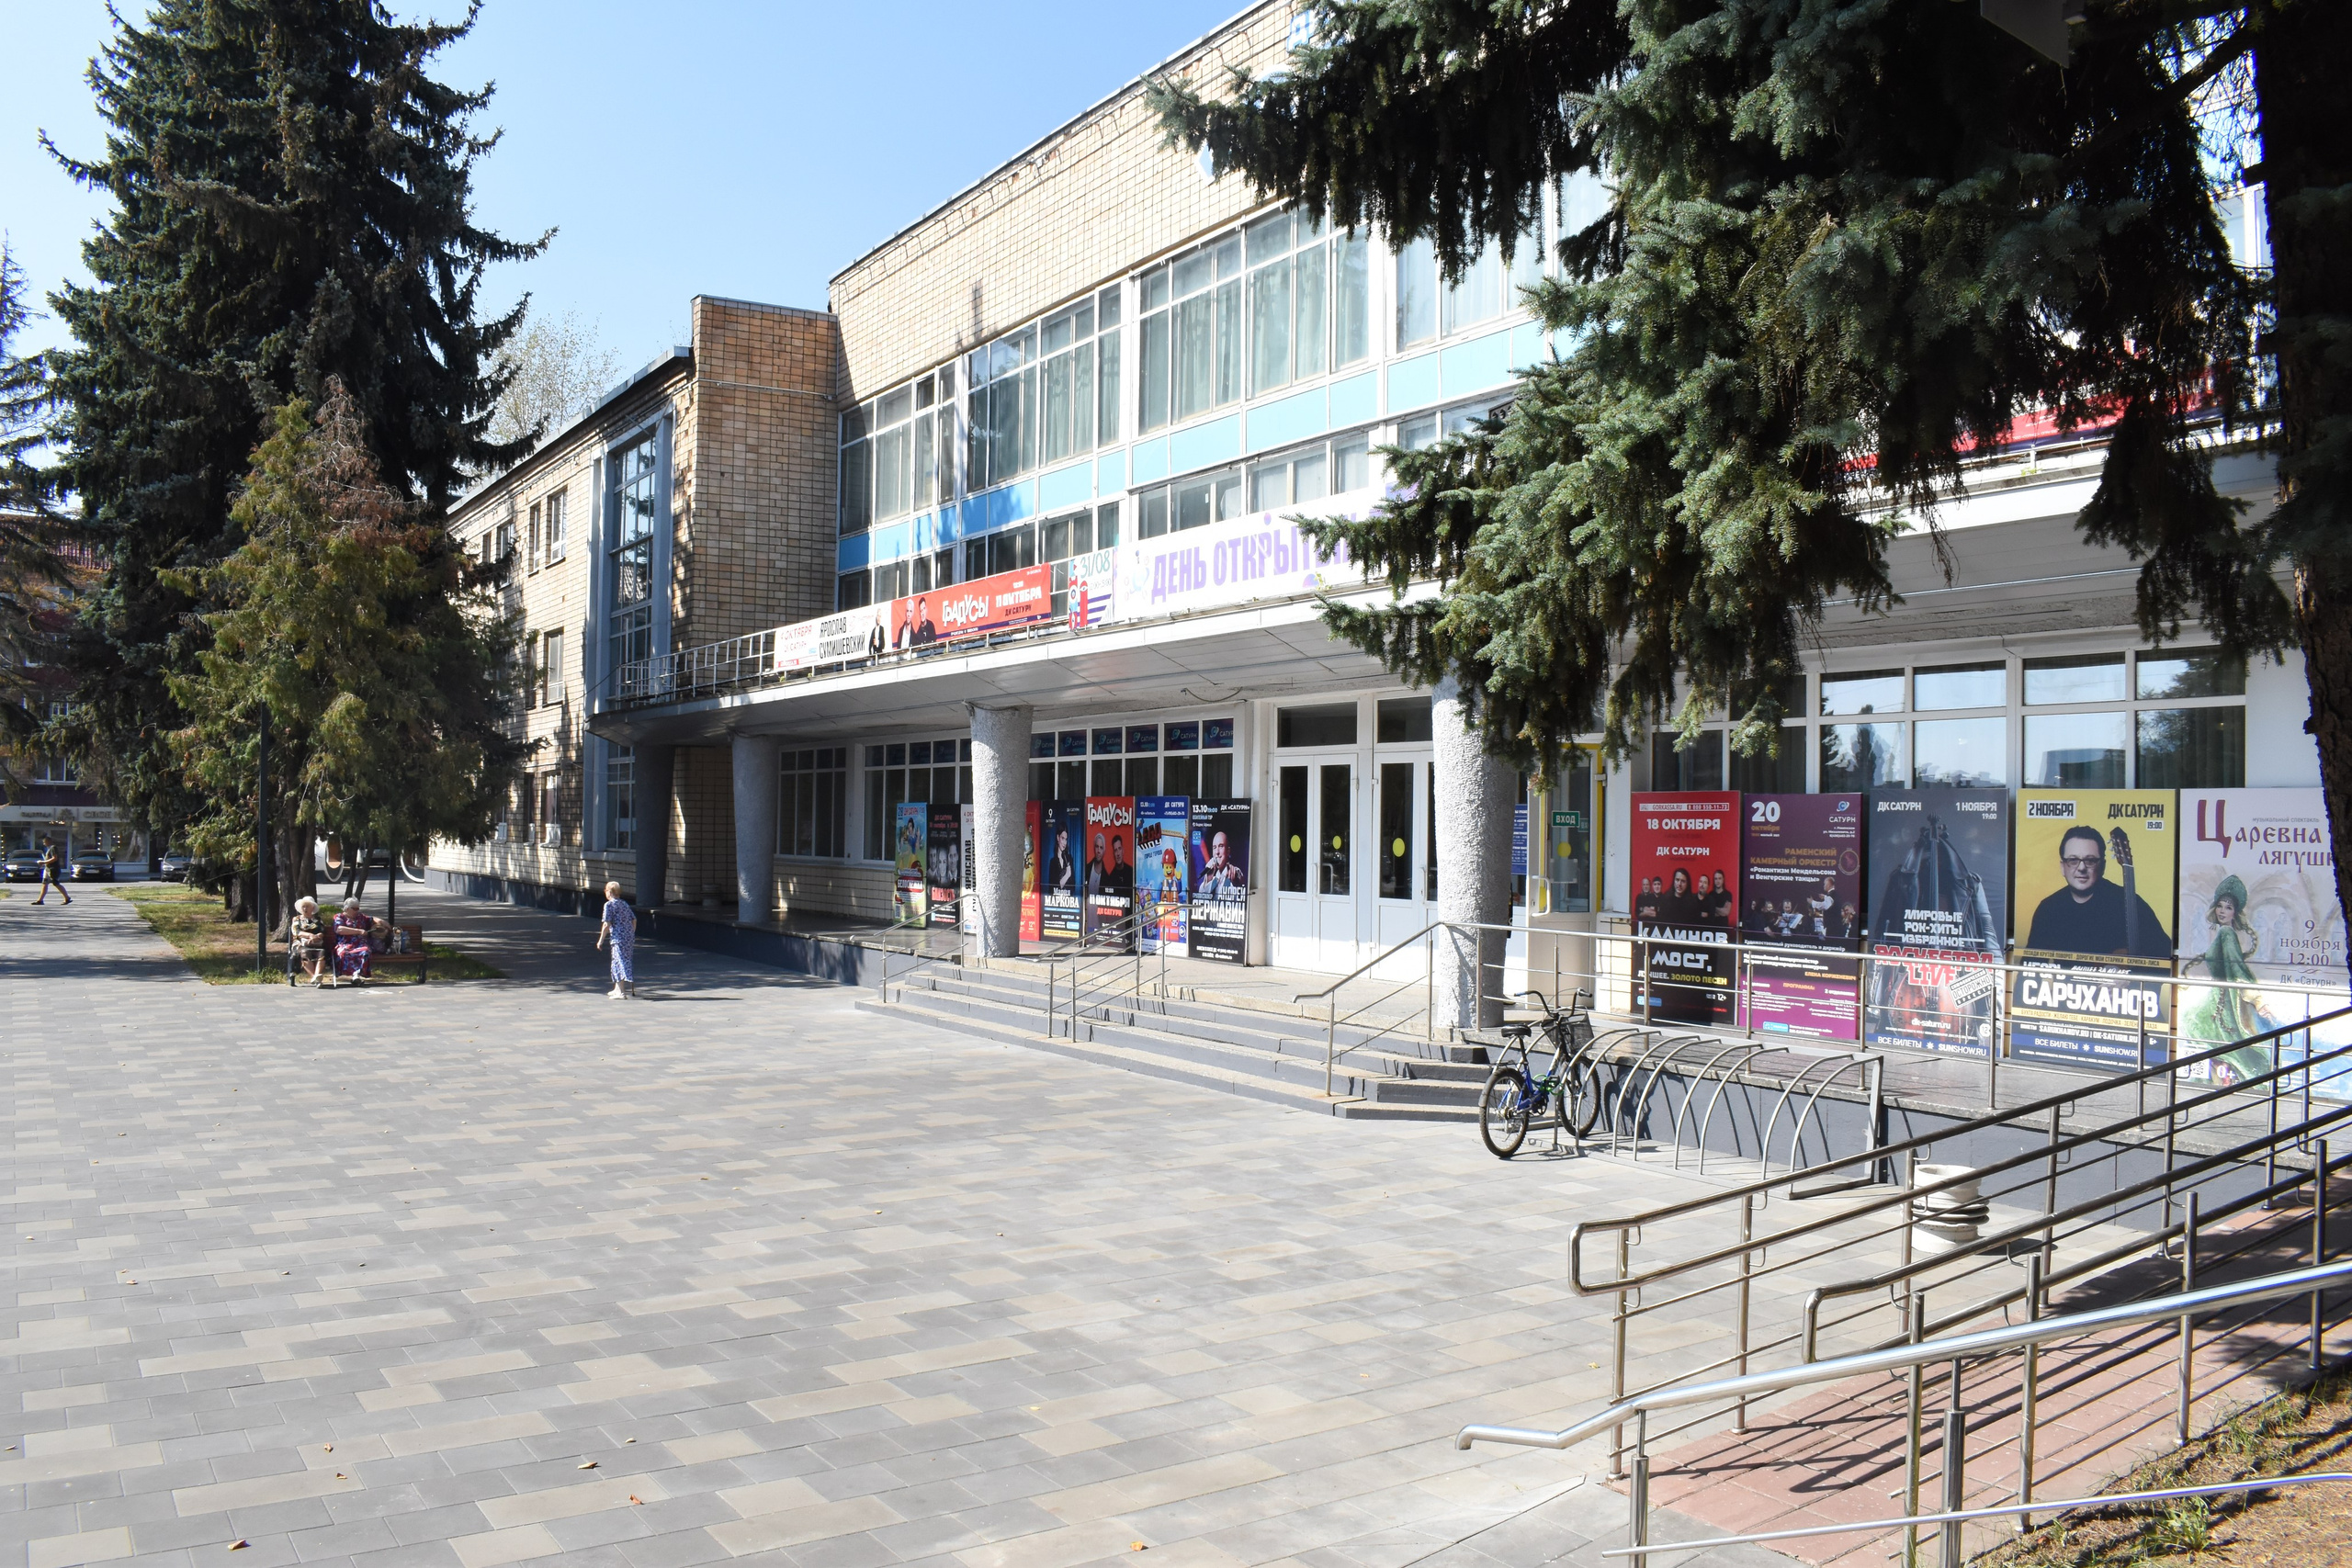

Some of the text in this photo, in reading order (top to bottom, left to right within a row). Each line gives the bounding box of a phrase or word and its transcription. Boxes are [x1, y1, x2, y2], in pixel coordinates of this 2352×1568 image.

[1080, 550, 1110, 579] 31/08
[1151, 547, 1206, 604] ДЕНЬ
[1002, 586, 1042, 604] ОКТЯБРЯ
[1005, 604, 1032, 618] ДК САТУРН
[820, 617, 846, 638] ЯРОСЛАВ
[820, 632, 865, 659] СУМИШЕВСКИЙ
[1048, 808, 1053, 818] 9
[1193, 805, 1207, 813] 13.10
[1751, 801, 1781, 822] 20
[1877, 802, 1922, 812] ДК САТУРН
[1955, 802, 1996, 812] 1 НОЯБРЯ
[2029, 803, 2074, 817] 2 НОЯБРЯ
[2108, 804, 2164, 819] ДК САТУРН
[1555, 815, 1576, 825] ВХОД
[1647, 818, 1721, 829] 18 ОКТЯБРЯ
[1138, 839, 1162, 851] ШОУ
[1657, 847, 1710, 856] ДК САТУРН
[1785, 848, 1837, 856] РАМЕНСКИЙ
[1750, 857, 1837, 866] КАМЕРНЫЙ ОРКЕСТР
[1756, 874, 1793, 882] Венгерские
[1218, 885, 1246, 901] АНДРЕЙ
[1045, 896, 1080, 908] МАРКОВА
[1096, 895, 1130, 908] ОКТЯБРЯ
[1191, 899, 1245, 923] ДЕРЖАВИН
[1904, 909, 1962, 922] МИРОВЫЕ
[1904, 921, 1962, 935] РОК-ХИТЫ
[2305, 919, 2314, 934] 9
[1902, 934, 1964, 947] ИЗБРАННОЕ
[2280, 936, 2340, 953] ноября
[2127, 958, 2159, 966] СКРИПКА-ЛИСА
[2289, 953, 2329, 965] 12:00
[1671, 973, 1701, 983] ЗОЛОТО
[1702, 976, 1727, 986] ПЕСЕН
[2280, 975, 2336, 987] ДК «Сатурн»
[1952, 976, 1990, 998] ОСТОРОЖНО
[2023, 979, 2158, 1018] САРУХАНОВ
[1911, 1018, 1951, 1029] dk-saturn.ru
[2039, 1024, 2090, 1038] SARUKHANOV.RU
[2093, 1032, 2138, 1043] DK-SATURN.RU
[1877, 1036, 1922, 1047] ВСЕ БИЛЕТЫ
[2035, 1038, 2078, 1050] ВСЕ БИЛЕТЫ
[1938, 1043, 1986, 1056] SUNSHOW.RU
[2217, 1066, 2235, 1079] 0+
